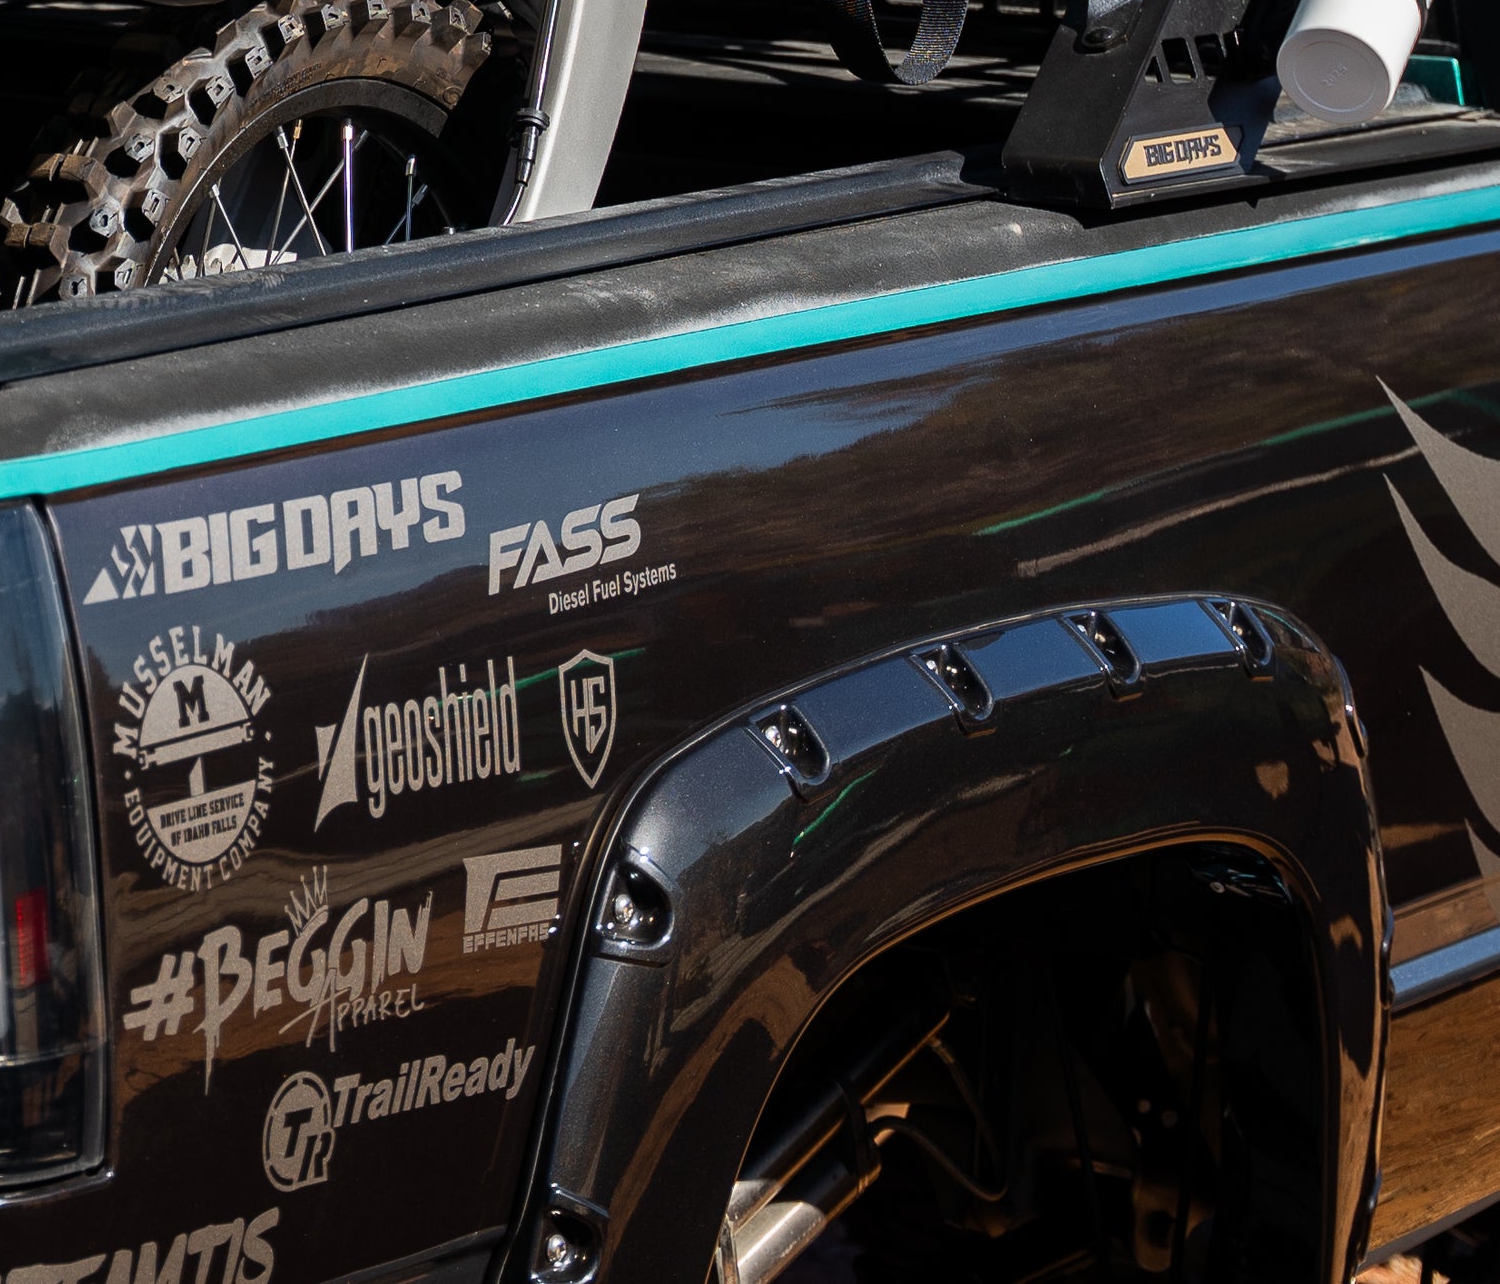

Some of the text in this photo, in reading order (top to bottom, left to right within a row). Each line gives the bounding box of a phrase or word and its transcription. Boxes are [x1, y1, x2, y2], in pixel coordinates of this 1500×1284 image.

[1143, 134, 1222, 167] BIG DAYS
[156, 470, 465, 595] BIG DAYS
[488, 493, 641, 595] FASS
[548, 563, 677, 615] Diesel Fuel Systems
[112, 625, 272, 760] MUSSELMAN
[172, 674, 210, 729] M
[570, 676, 607, 754] HS
[363, 656, 520, 819] geoshield
[124, 756, 275, 892] EQUIPMENT COMPANY
[160, 792, 245, 830] DRIVE LINE SERVICE
[171, 815, 238, 847] OF IDAHO FALLS
[333, 1038, 536, 1128] TrailReady
